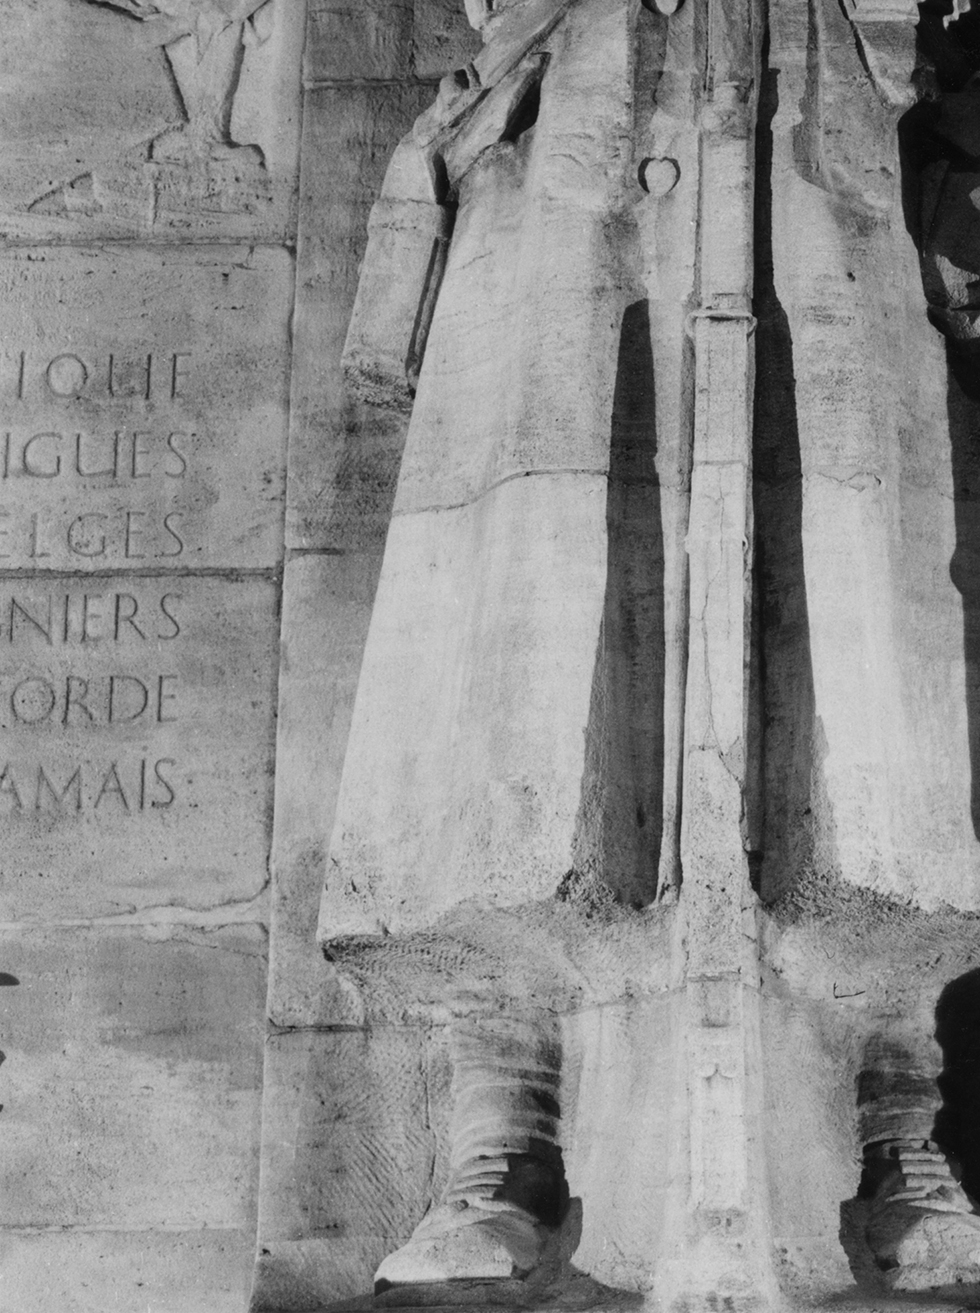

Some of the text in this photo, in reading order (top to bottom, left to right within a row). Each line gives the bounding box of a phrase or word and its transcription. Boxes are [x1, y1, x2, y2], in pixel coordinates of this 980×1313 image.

[3, 431, 186, 479] IGUES
[9, 592, 183, 644] NIERS
[10, 674, 178, 727] ORDE
